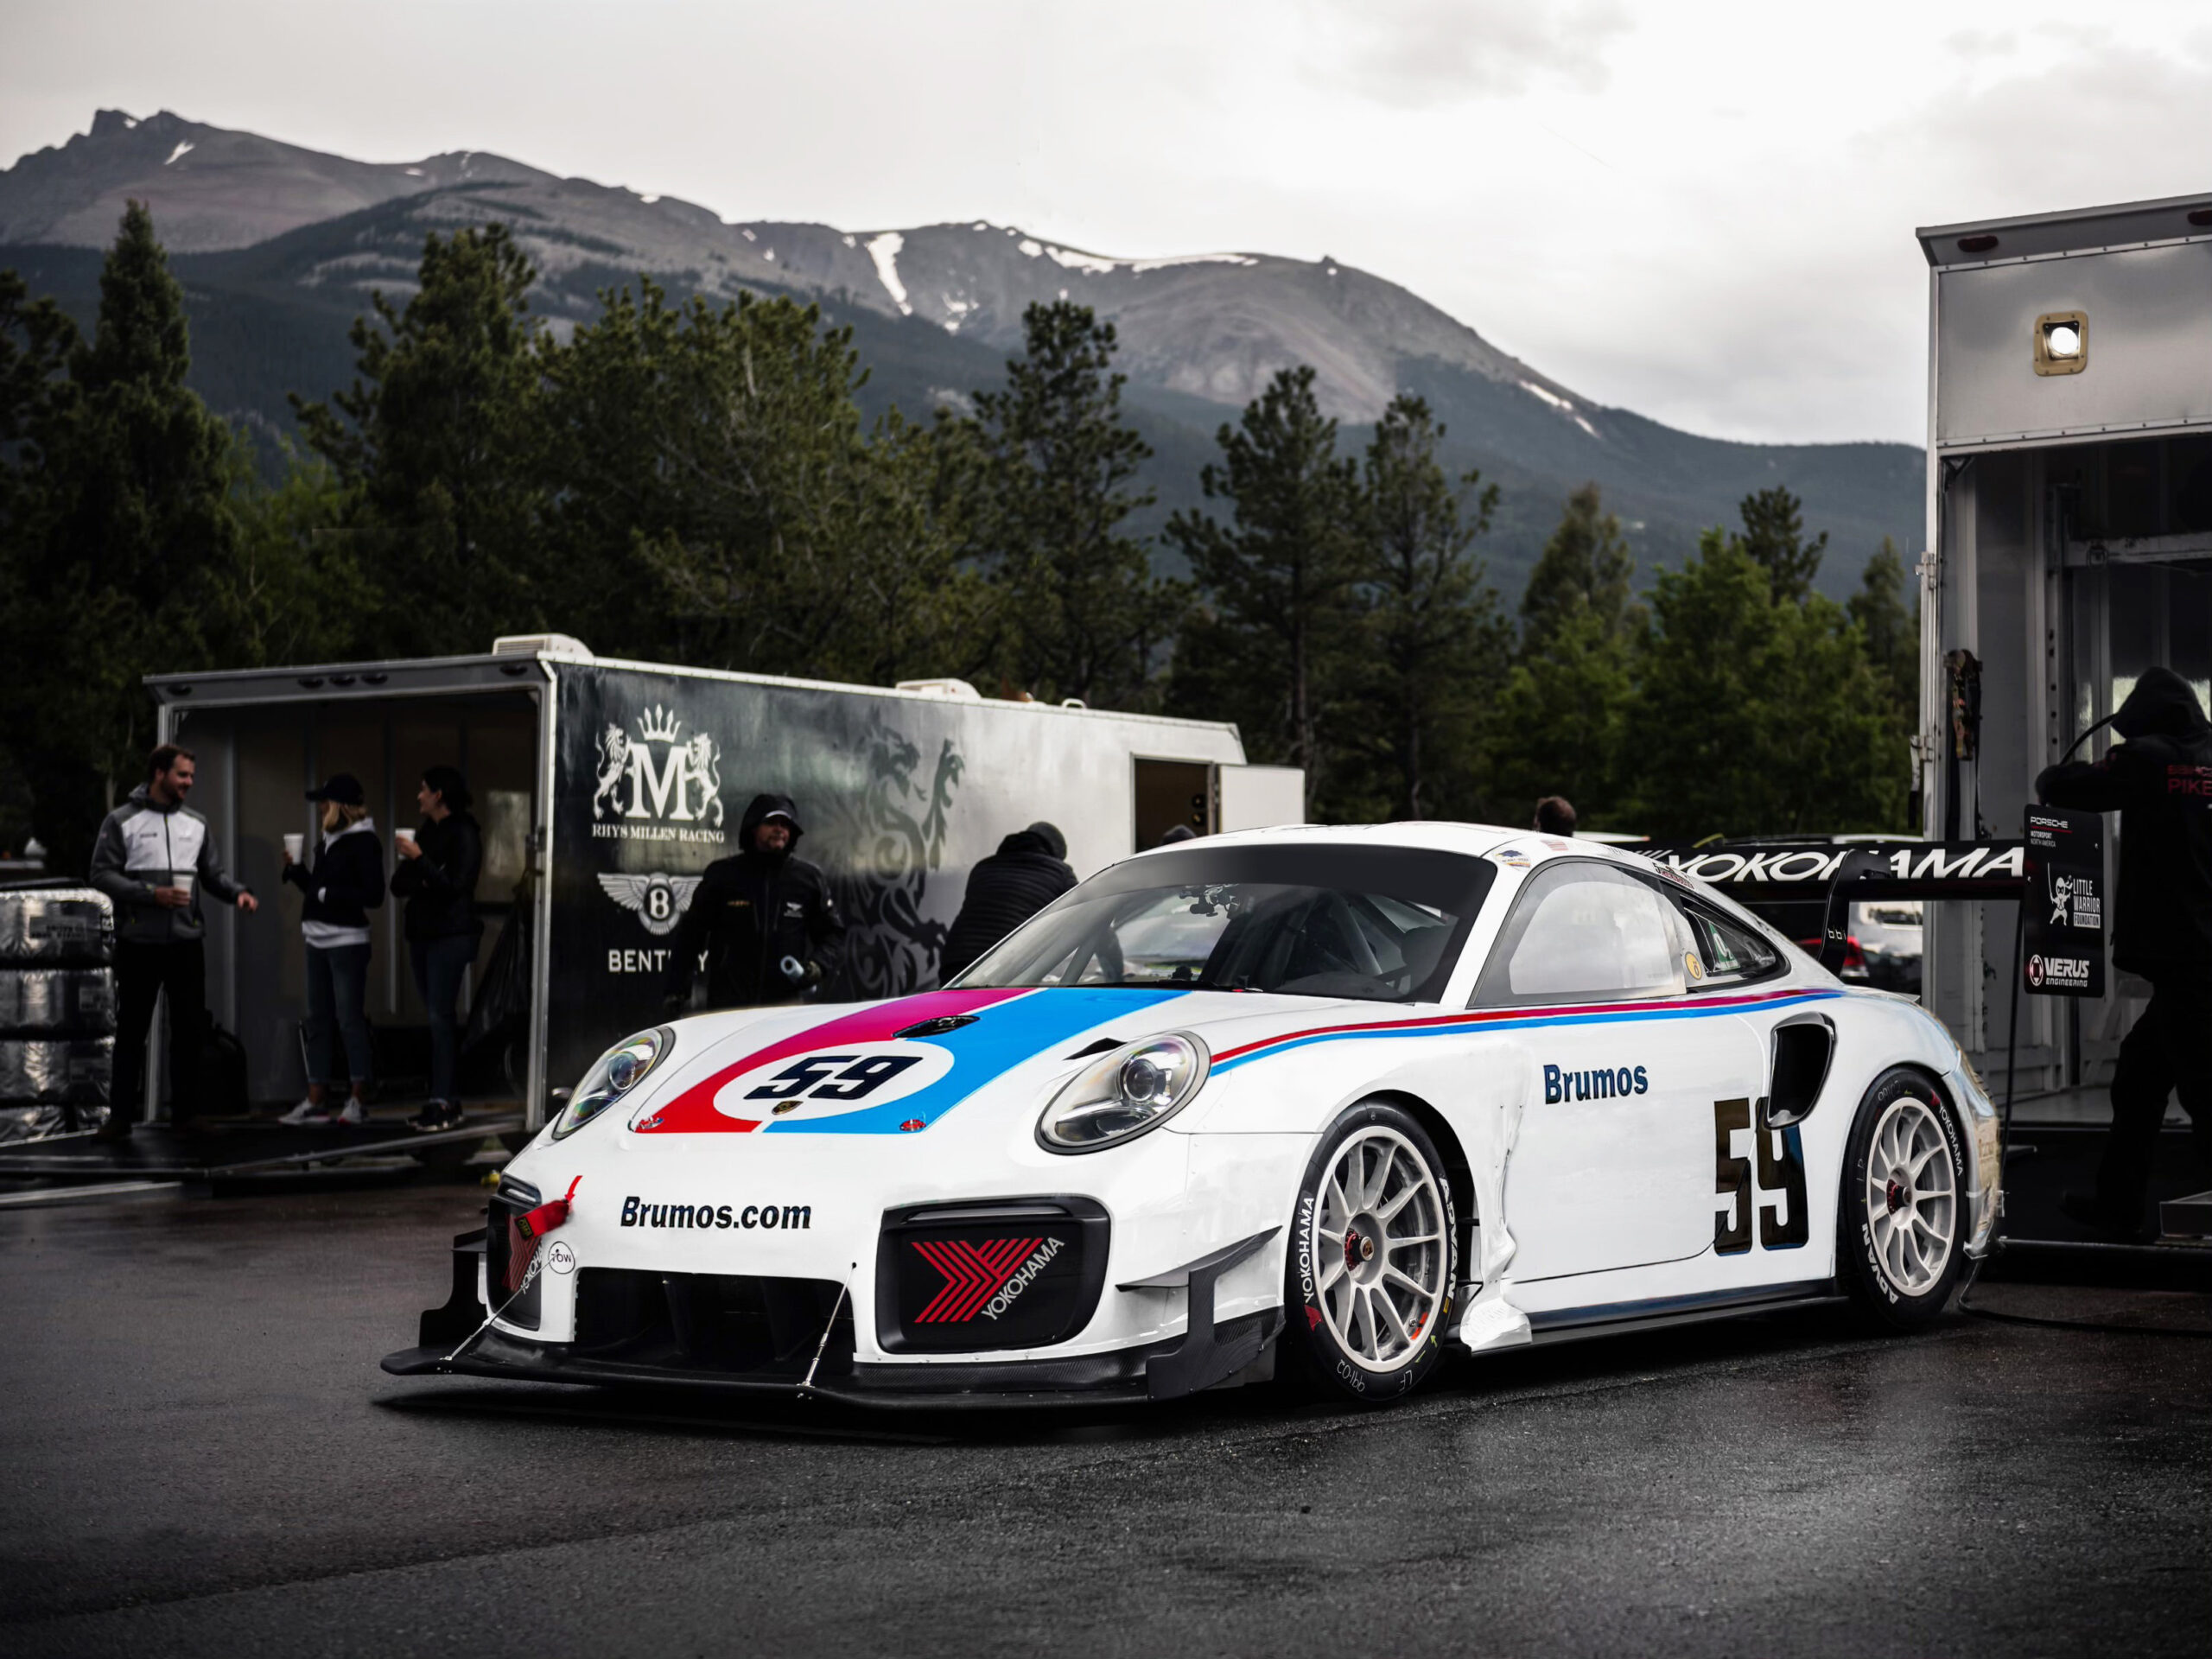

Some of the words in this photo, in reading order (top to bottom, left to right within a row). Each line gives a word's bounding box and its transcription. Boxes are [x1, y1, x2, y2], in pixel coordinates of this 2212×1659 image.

[625, 743, 694, 820] M
[592, 823, 628, 838] RHYS
[630, 826, 676, 842] MILLEN
[679, 828, 725, 843] RACING
[2031, 817, 2069, 829] PORSCHE
[2073, 879, 2093, 896] LITTLE
[2074, 896, 2101, 913] WARRIOR
[2075, 914, 2100, 927] FOUNDATION
[609, 950, 709, 972] BENTY
[2044, 957, 2090, 978] VERUS
[2046, 977, 2088, 988] ENGINEERING
[743, 1055, 923, 1100] 59
[1543, 1065, 1649, 1104] Brumos
[1939, 1102, 1963, 1177] YOKOHAMA
[1713, 1096, 1809, 1257] 59
[620, 1196, 811, 1230] Brumos.com
[551, 1254, 572, 1262] TOW
[1300, 1197, 1315, 1304] YOKOHAMA
[1862, 1223, 1899, 1305] ADVAN
[981, 1236, 1065, 1320] YOKOHAMA
